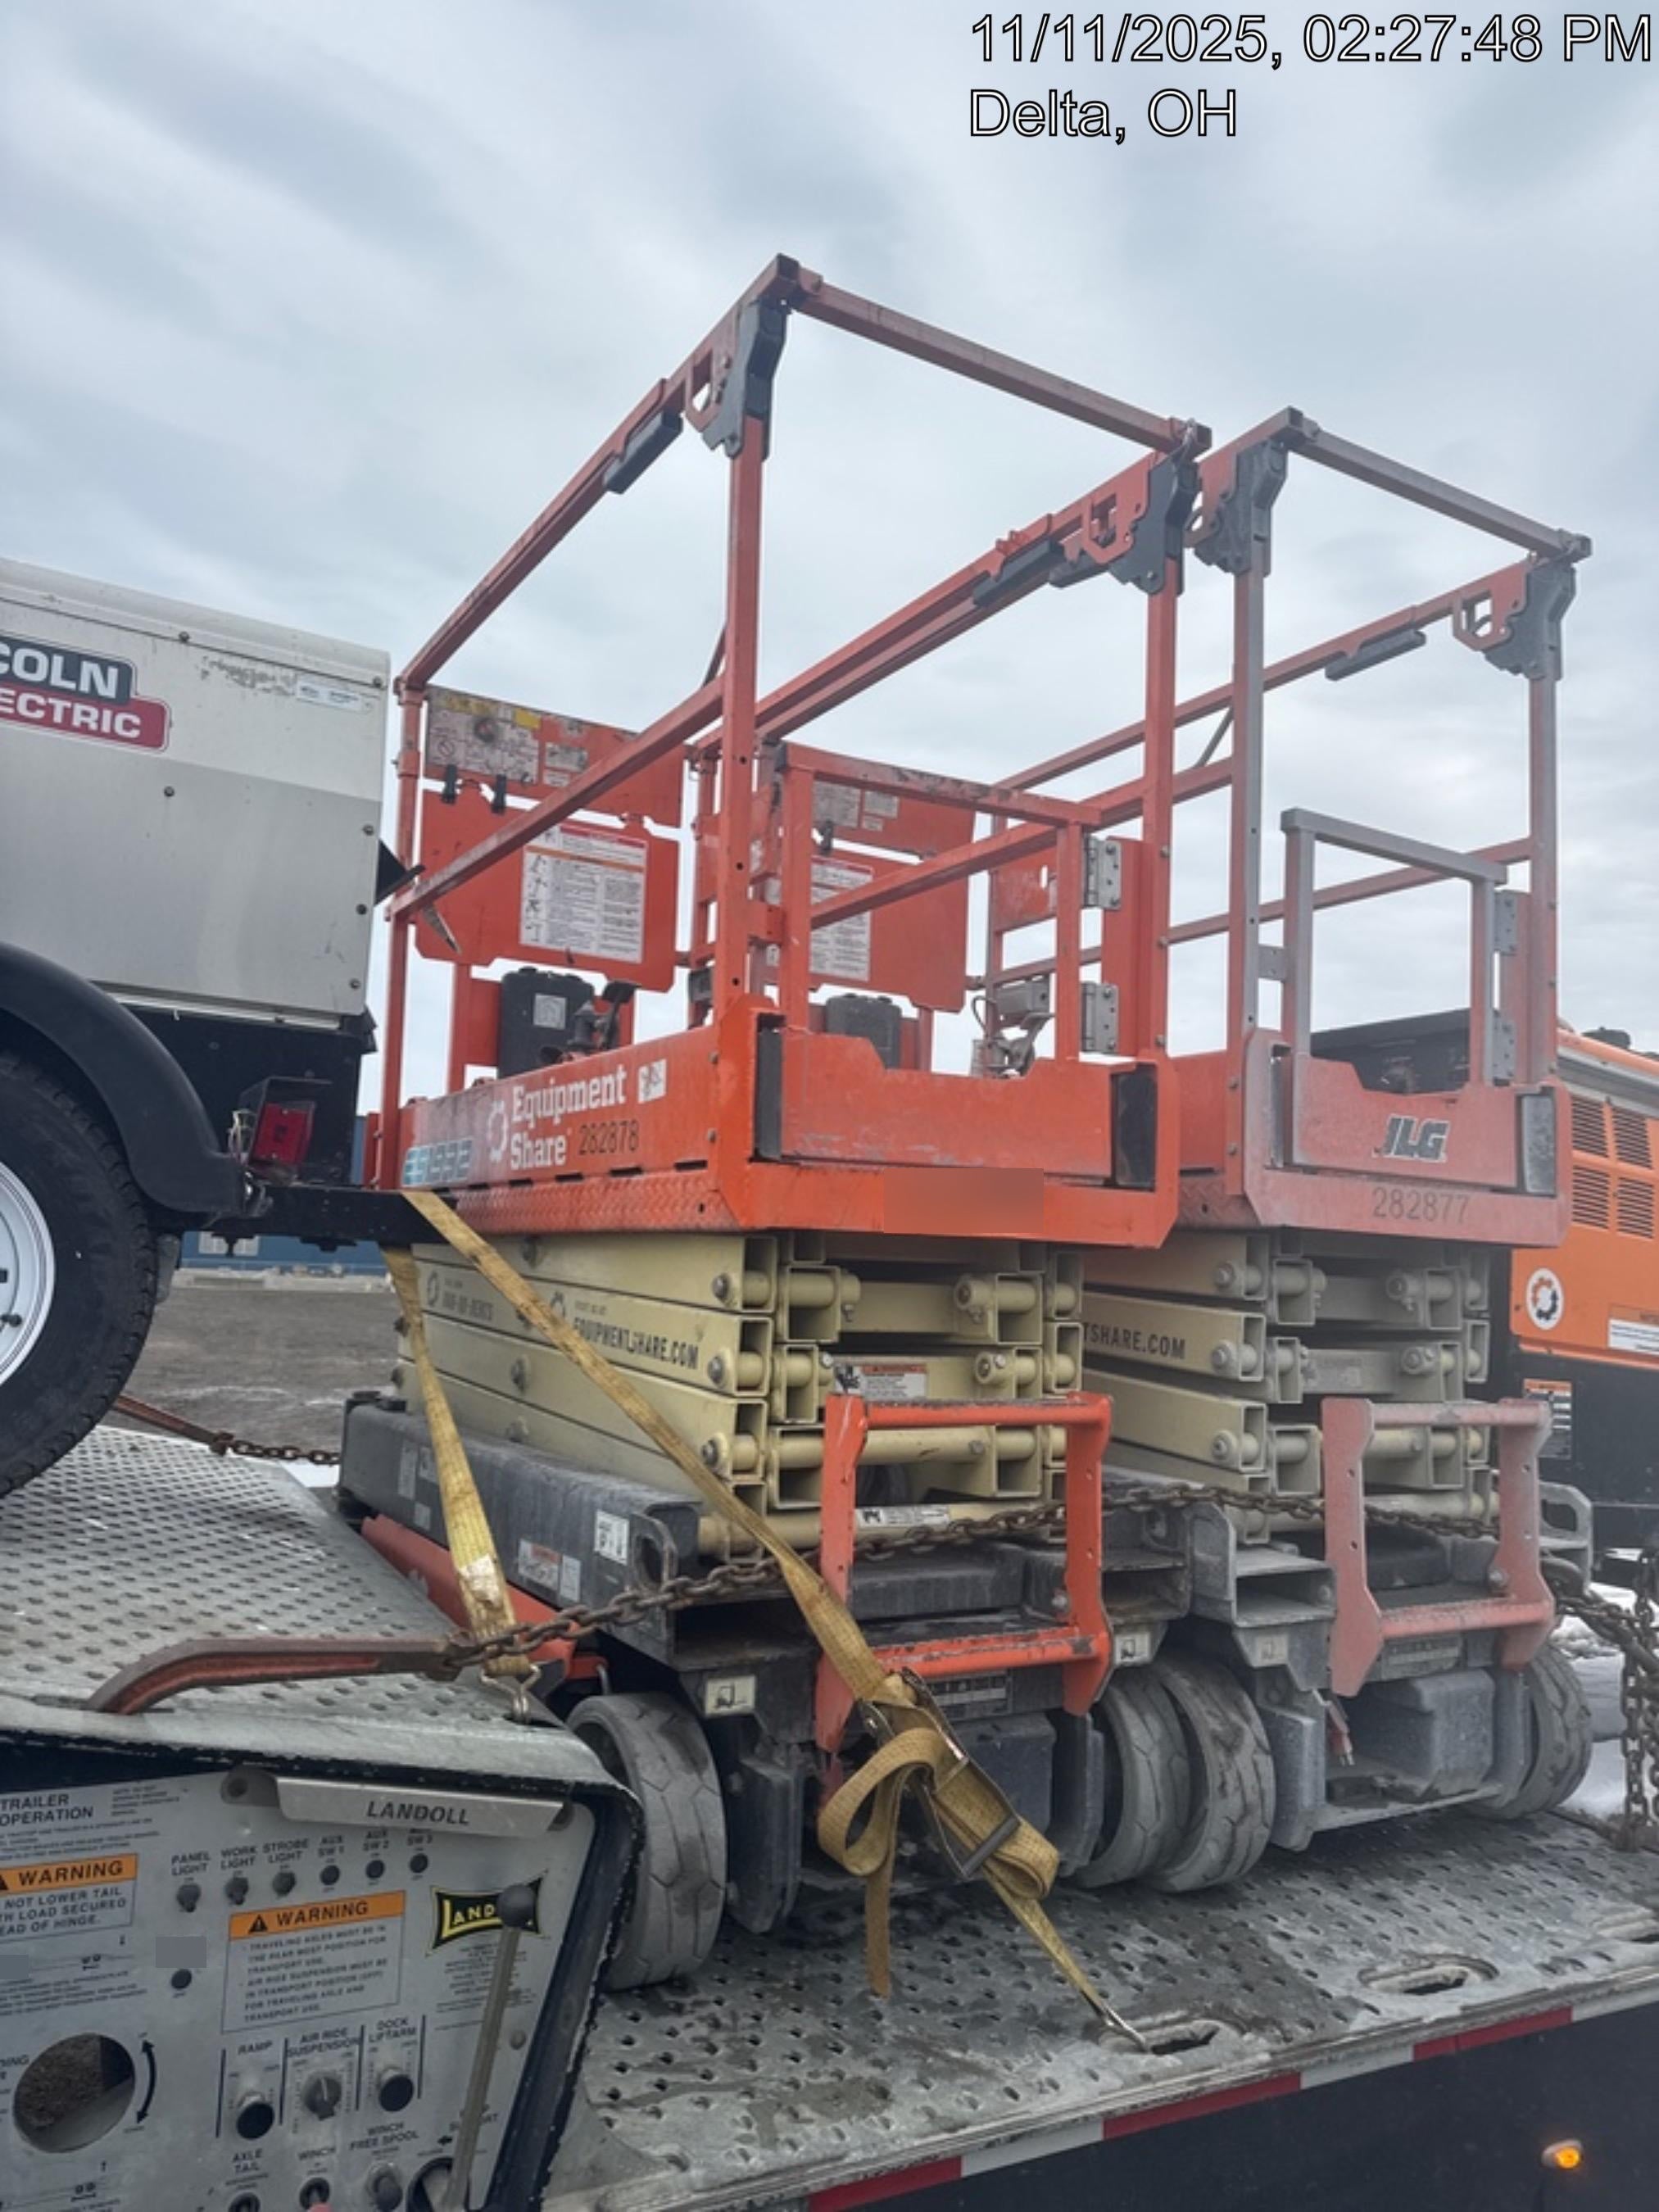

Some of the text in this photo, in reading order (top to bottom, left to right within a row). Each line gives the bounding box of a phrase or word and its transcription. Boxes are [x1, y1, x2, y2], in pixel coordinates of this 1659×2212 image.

[510, 1063, 627, 1129] Equipment
[578, 1118, 640, 1156] 282878
[1371, 1113, 1450, 1163] JLG
[510, 1132, 567, 1170] Share
[1372, 1188, 1470, 1224] 282877
[1, 1793, 69, 1812] TRAILER
[366, 1801, 469, 1825] LANDOLL
[0, 1806, 94, 1827] OPERATION
[171, 1852, 211, 1865] PANEL
[220, 1845, 257, 1859] WORK
[220, 1856, 256, 1870] LIGHT
[269, 1850, 302, 1864] LIGHT
[18, 1861, 123, 1887] WARNING
[171, 1863, 208, 1877] LIGHT
[4, 1887, 121, 1911] NOT LOWER TAIL
[19, 1906, 57, 1921] LOAD
[61, 1898, 126, 1915] SECURED
[277, 1901, 369, 1927] WARNING
